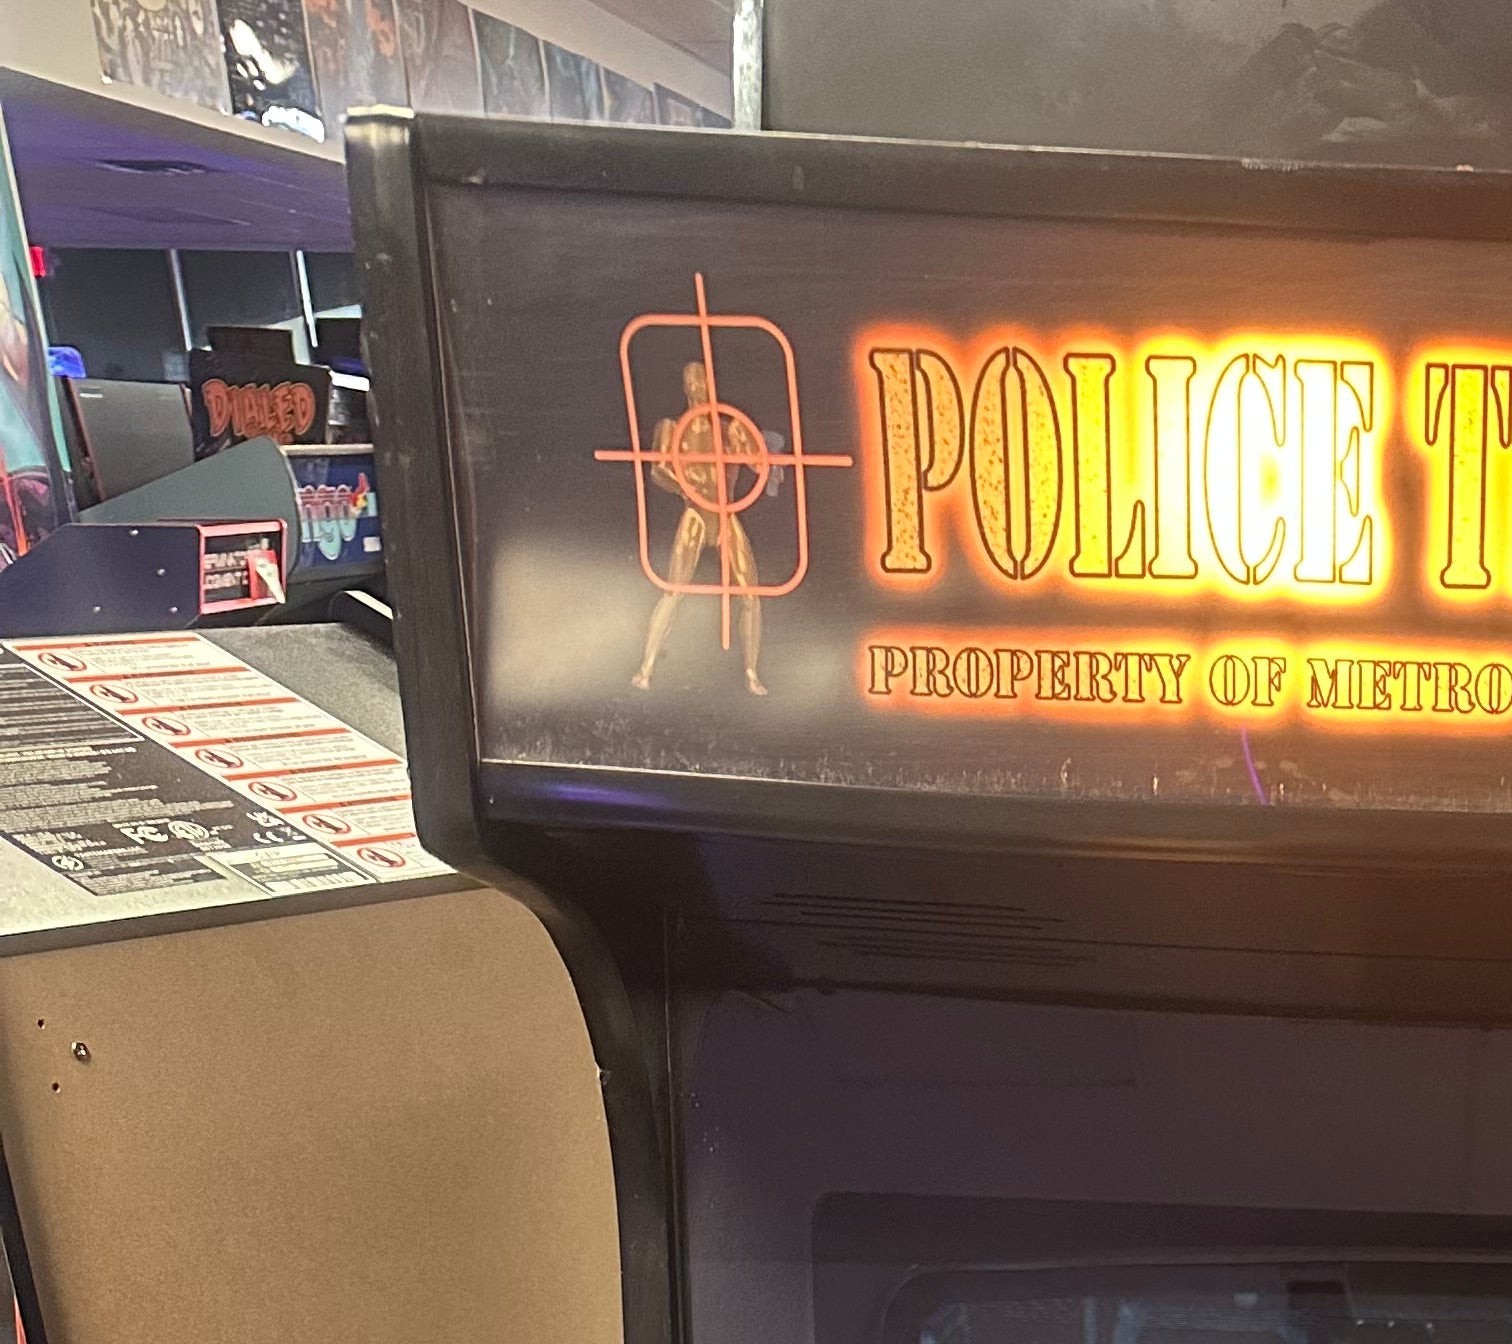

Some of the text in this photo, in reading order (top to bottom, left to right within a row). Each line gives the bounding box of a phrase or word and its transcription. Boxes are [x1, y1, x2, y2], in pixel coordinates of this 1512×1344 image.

[868, 346, 1375, 585] POLICE
[867, 644, 1191, 703] PROPERTY
[1208, 654, 1287, 707] OF
